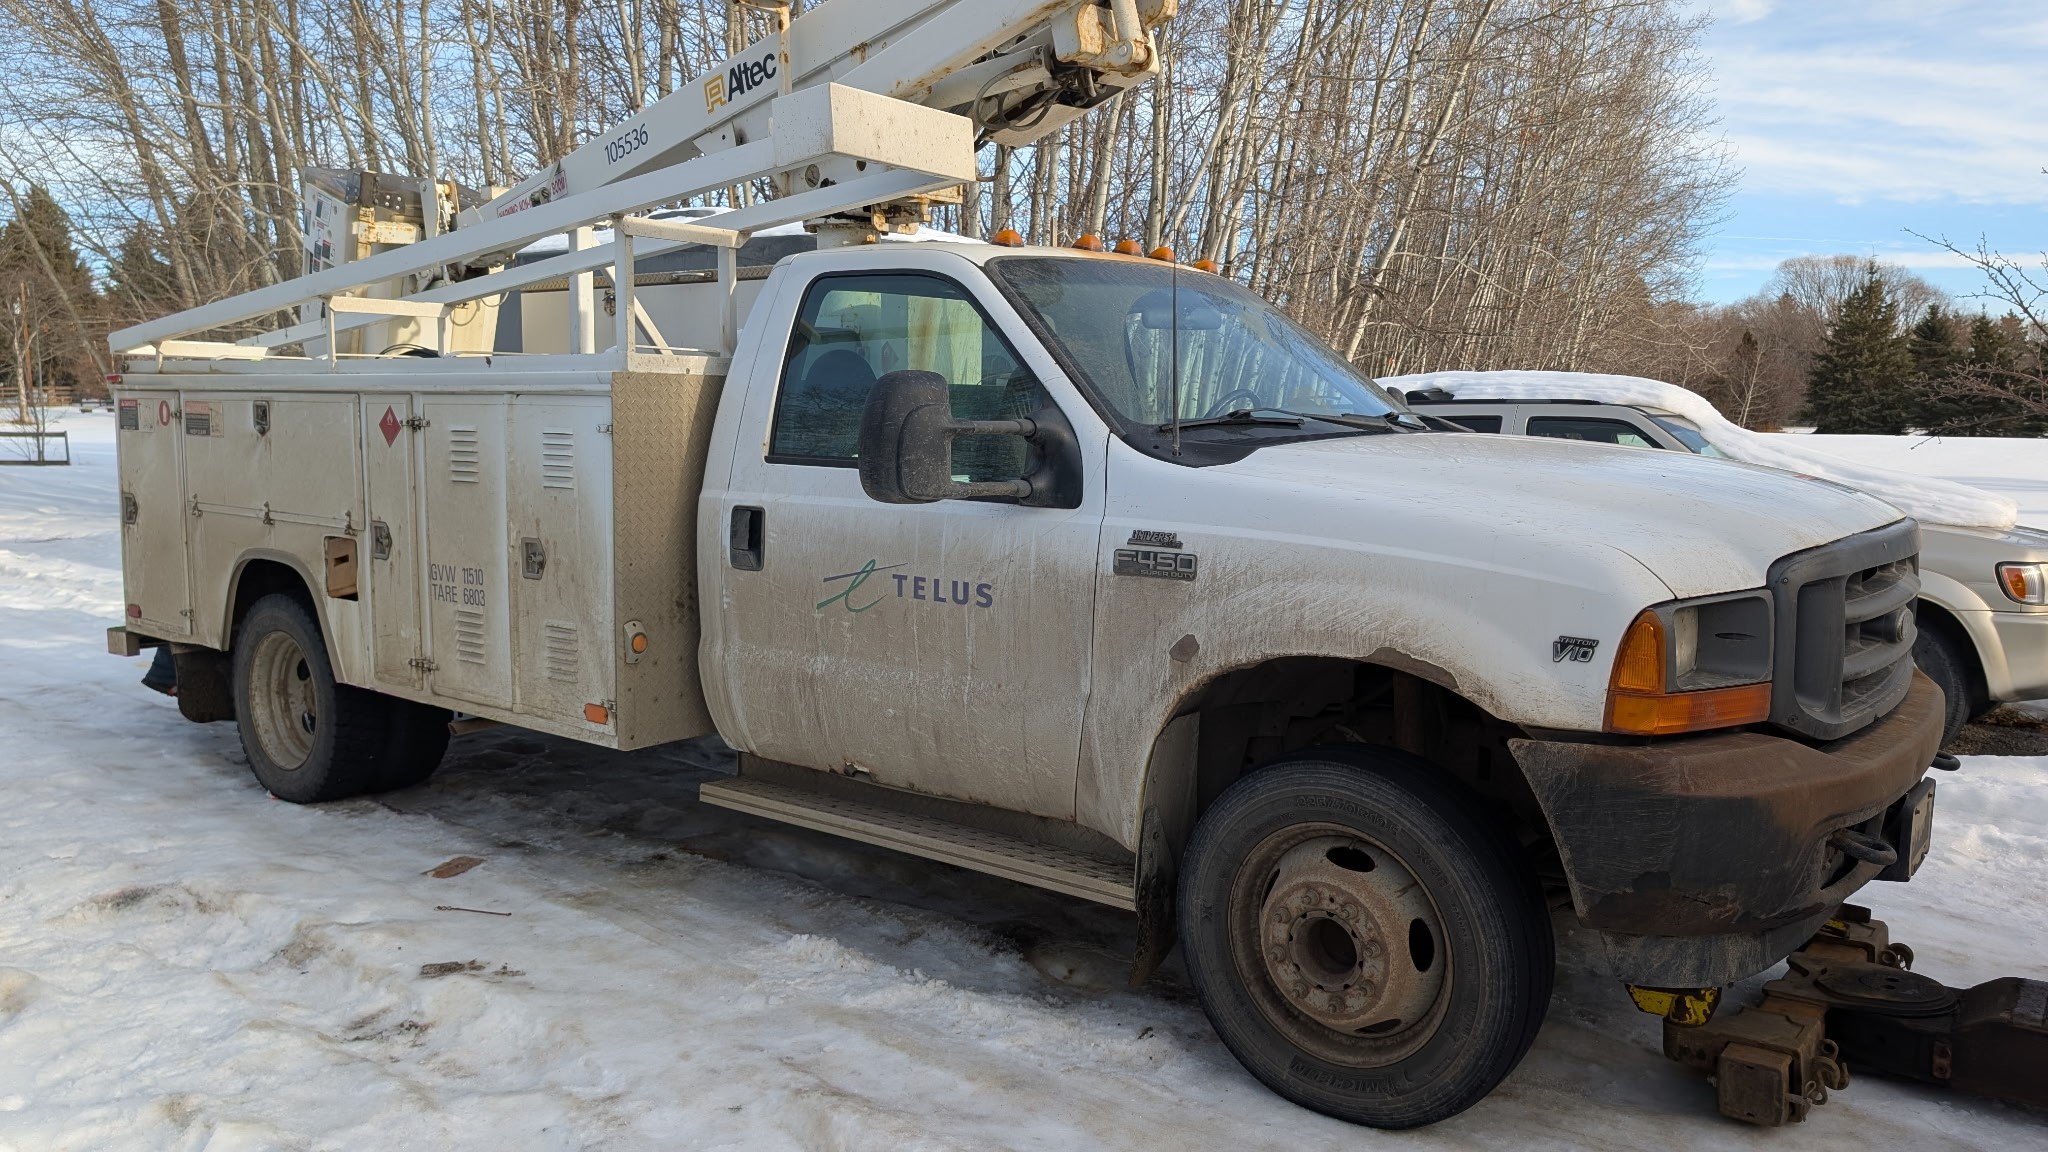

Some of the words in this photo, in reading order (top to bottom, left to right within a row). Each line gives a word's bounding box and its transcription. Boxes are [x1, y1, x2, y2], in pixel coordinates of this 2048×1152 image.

[728, 53, 777, 102] Altec
[604, 123, 649, 165] 105536
[431, 563, 456, 583] GVW
[462, 567, 484, 586] 11510
[1140, 569, 1169, 577] SUPER
[1171, 571, 1195, 579] DUTY
[432, 583, 458, 603] TARE
[463, 587, 486, 607] 6803
[892, 573, 993, 608] TELUS
[1553, 641, 1594, 662] V10
[1560, 637, 1598, 646] TRITON
